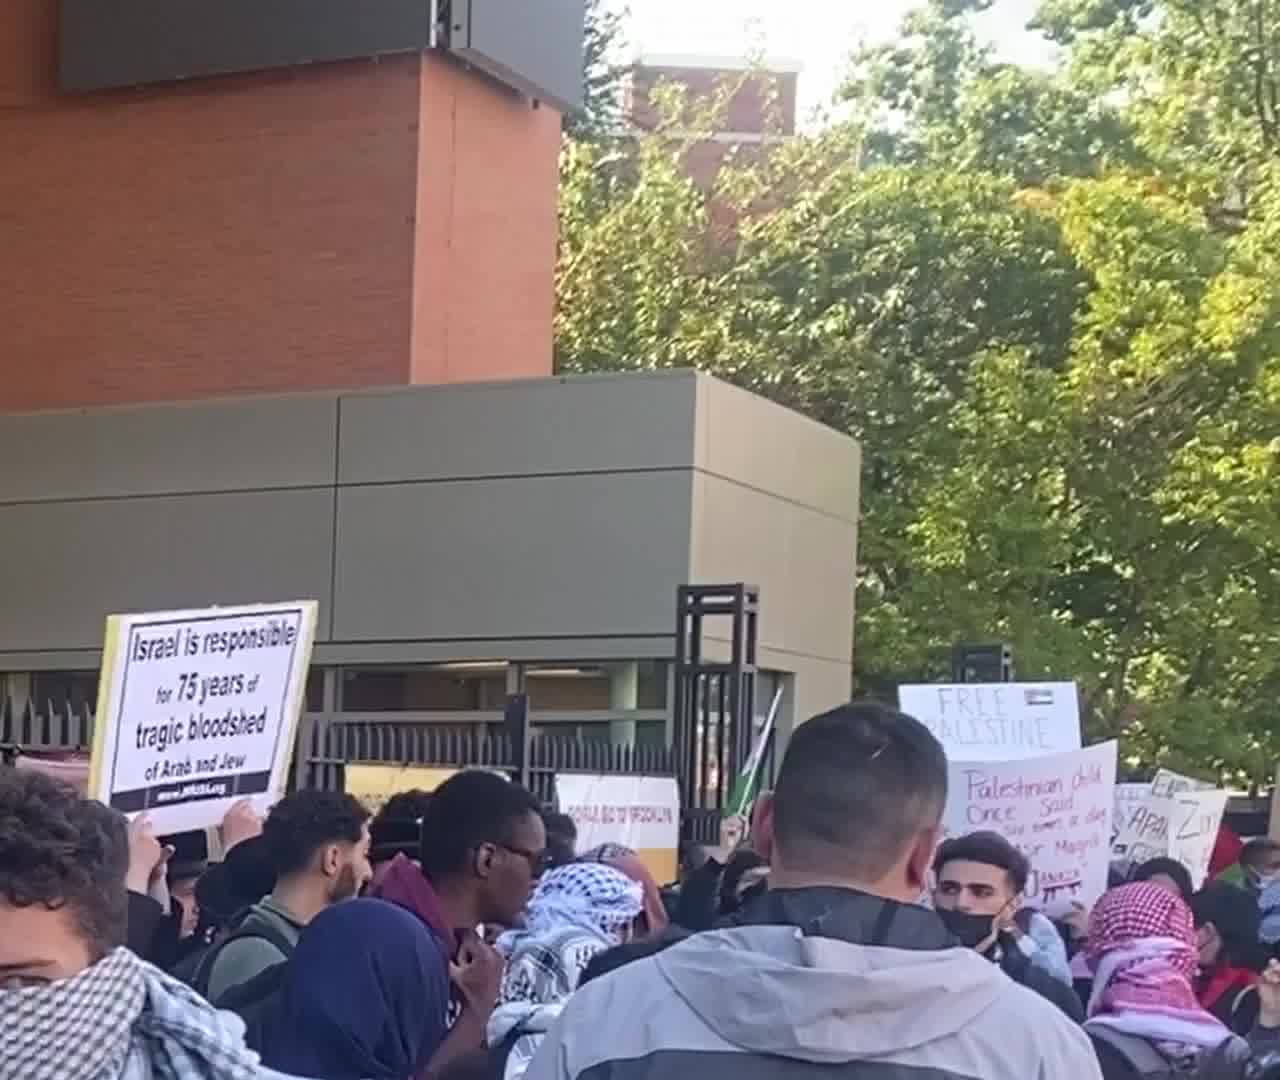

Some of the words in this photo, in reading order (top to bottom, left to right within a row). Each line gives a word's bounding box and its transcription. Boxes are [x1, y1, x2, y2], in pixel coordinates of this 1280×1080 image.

[133, 627, 181, 662] Israel
[183, 627, 200, 657] is
[202, 619, 296, 658] responsible
[155, 686, 173, 704] for
[176, 672, 199, 702] 75
[200, 673, 244, 706] years
[247, 674, 260, 693] of
[936, 687, 1009, 717] FREE
[135, 716, 185, 752] tragic
[187, 705, 268, 742] bloodshed
[144, 760, 160, 781] of
[159, 753, 192, 779] Arab
[195, 753, 219, 773] and
[219, 753, 248, 771] Jew
